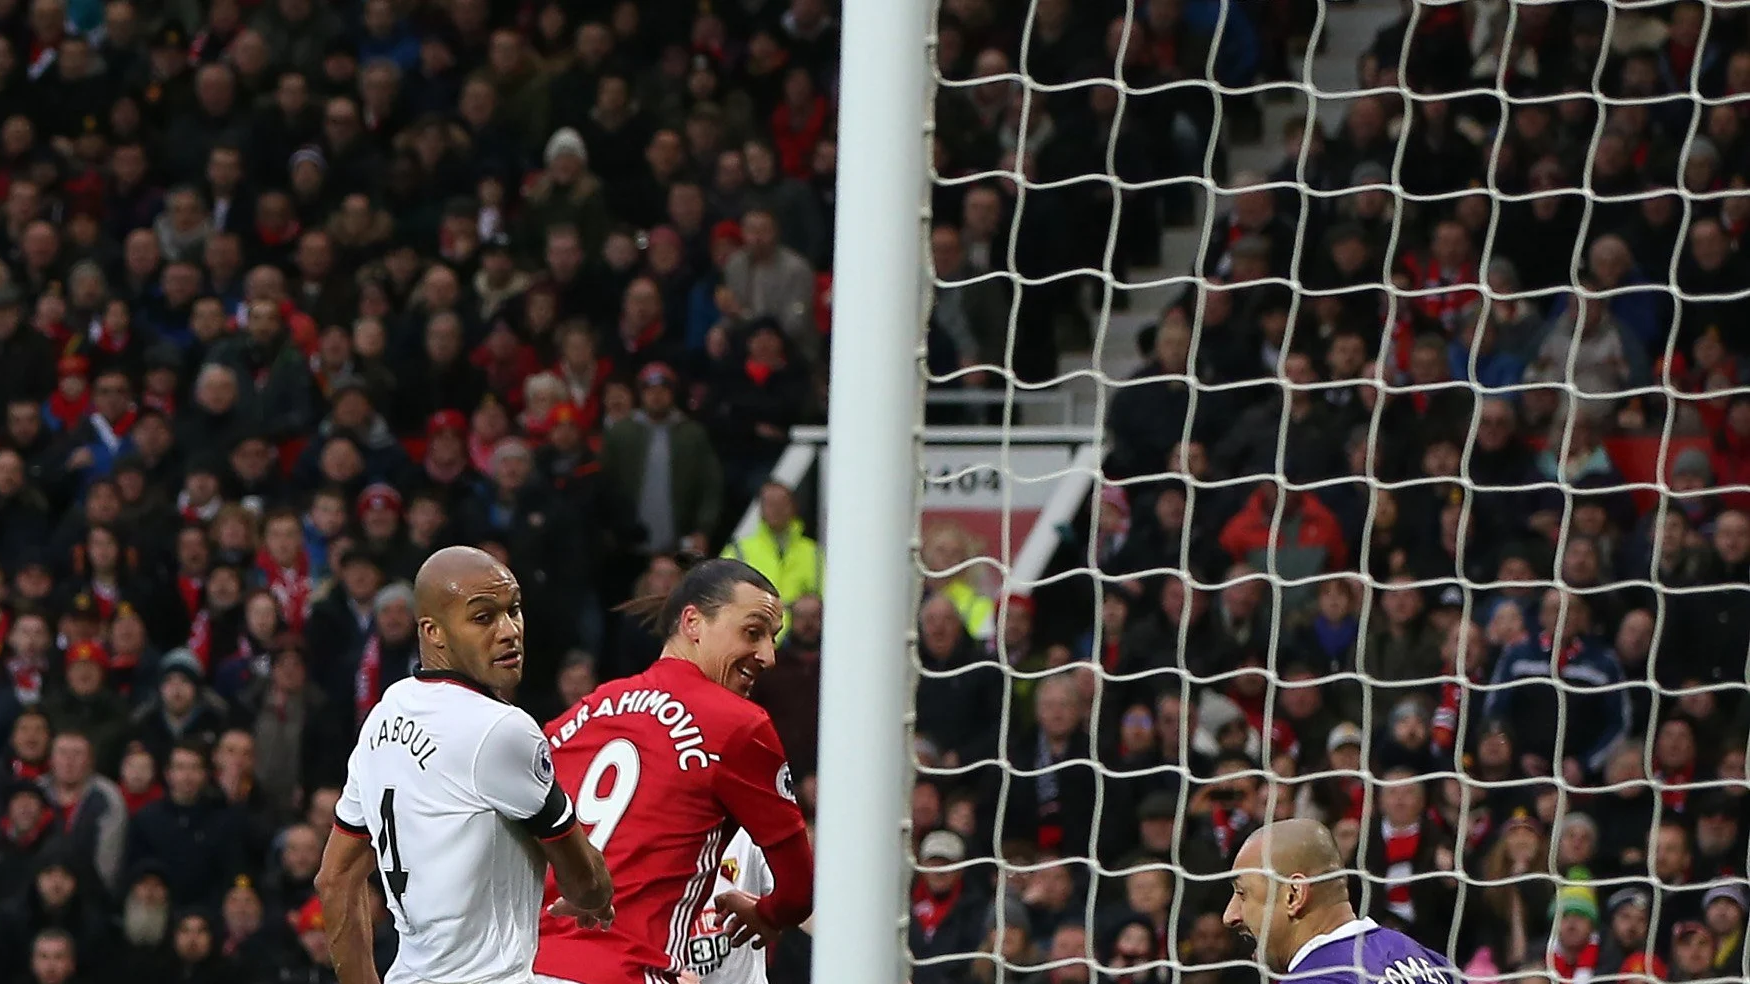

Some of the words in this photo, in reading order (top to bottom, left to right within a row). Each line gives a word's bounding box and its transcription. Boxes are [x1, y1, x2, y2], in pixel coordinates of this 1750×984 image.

[924, 465, 1001, 492] 404
[550, 689, 722, 771] IBRAHIMOVIĆ
[576, 738, 641, 852] 9
[378, 786, 410, 918] 4
[690, 932, 732, 964] 38
